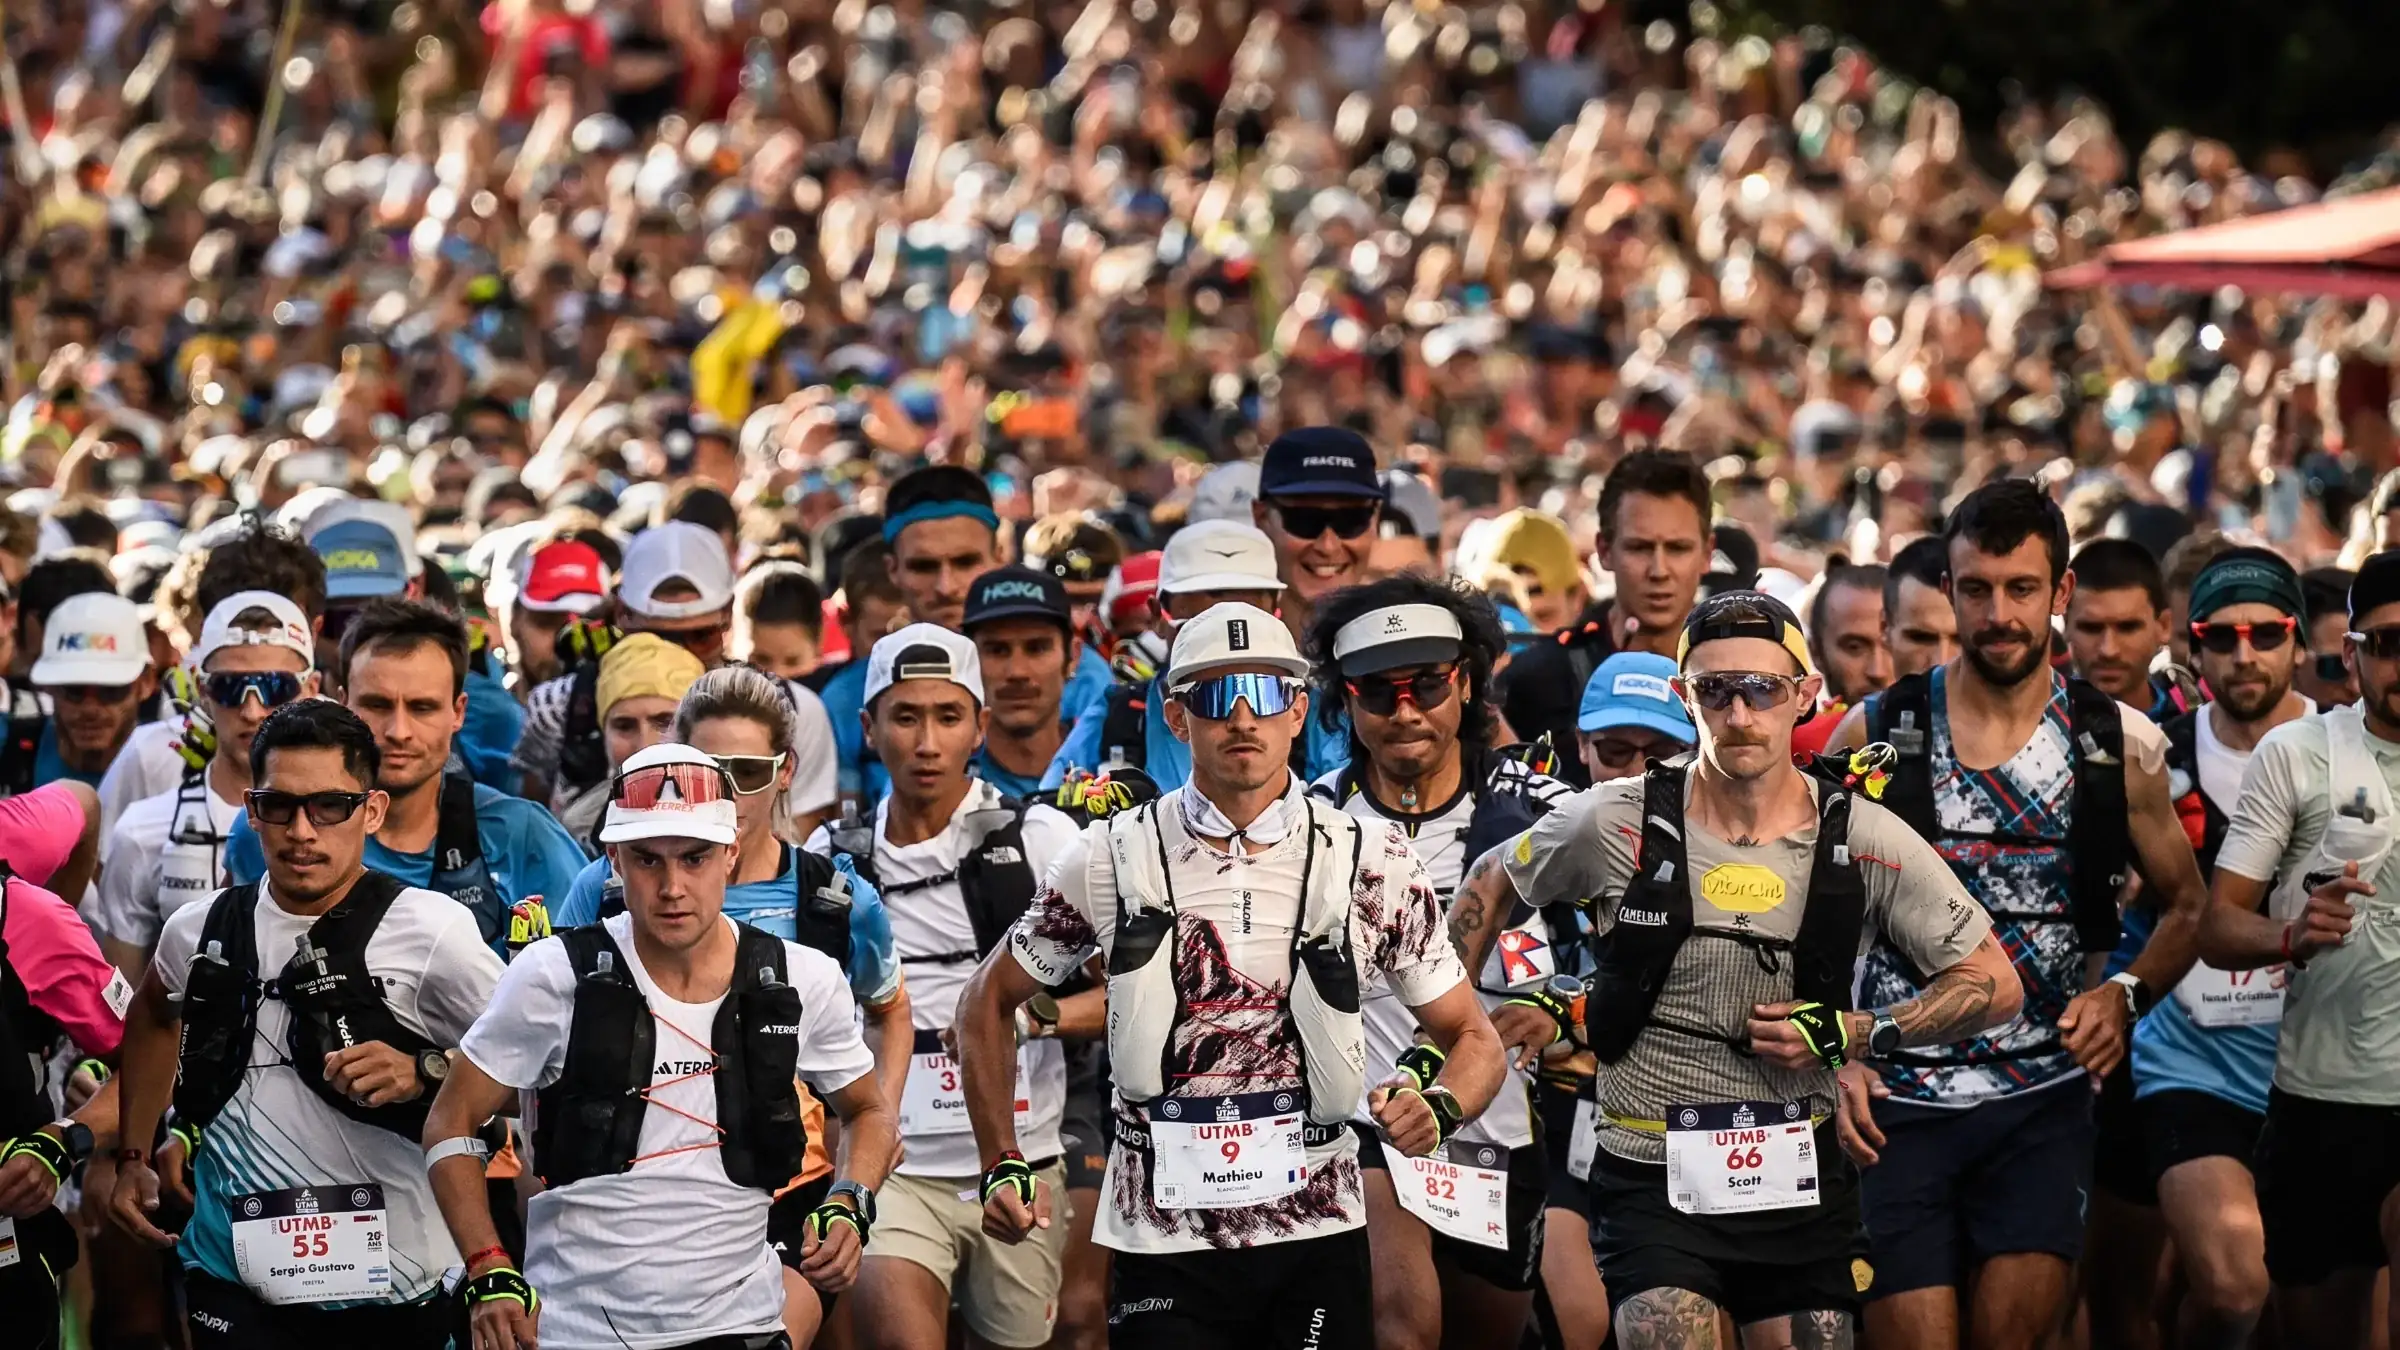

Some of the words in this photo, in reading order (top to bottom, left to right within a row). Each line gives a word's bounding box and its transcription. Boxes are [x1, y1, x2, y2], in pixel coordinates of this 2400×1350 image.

[1303, 456, 1356, 468] FRACTEL
[983, 580, 1045, 605] HOKA
[57, 632, 116, 652] HOKA
[656, 801, 696, 813] TERREX
[163, 876, 207, 890] TERREX
[452, 886, 481, 899] ARCH
[1242, 890, 1252, 934] SALOMN
[1618, 906, 1668, 926] CAMELBAK
[1026, 944, 1055, 977] i-run
[317, 974, 347, 985] PEREYRA
[319, 982, 336, 992] ARG
[1216, 1109, 1240, 1117] UTMB
[1199, 1123, 1253, 1140] UTMB
[1716, 1129, 1766, 1146] UTMB
[1220, 1141, 1240, 1164] 9
[1287, 1141, 1301, 1149] ANS
[1726, 1146, 1763, 1170] 66
[1202, 1169, 1263, 1184] Mathieu
[1414, 1159, 1458, 1179] UTMB
[1425, 1176, 1456, 1201] 82
[1728, 1176, 1762, 1188] Scott
[295, 1201, 319, 1209] UTMB
[279, 1215, 332, 1234] UTMB
[292, 1233, 329, 1258] 55
[270, 1264, 306, 1278] Sergio
[308, 1261, 355, 1273] Gustavo
[302, 1279, 325, 1287] PEREYRA
[1303, 1308, 1326, 1344] i-run
